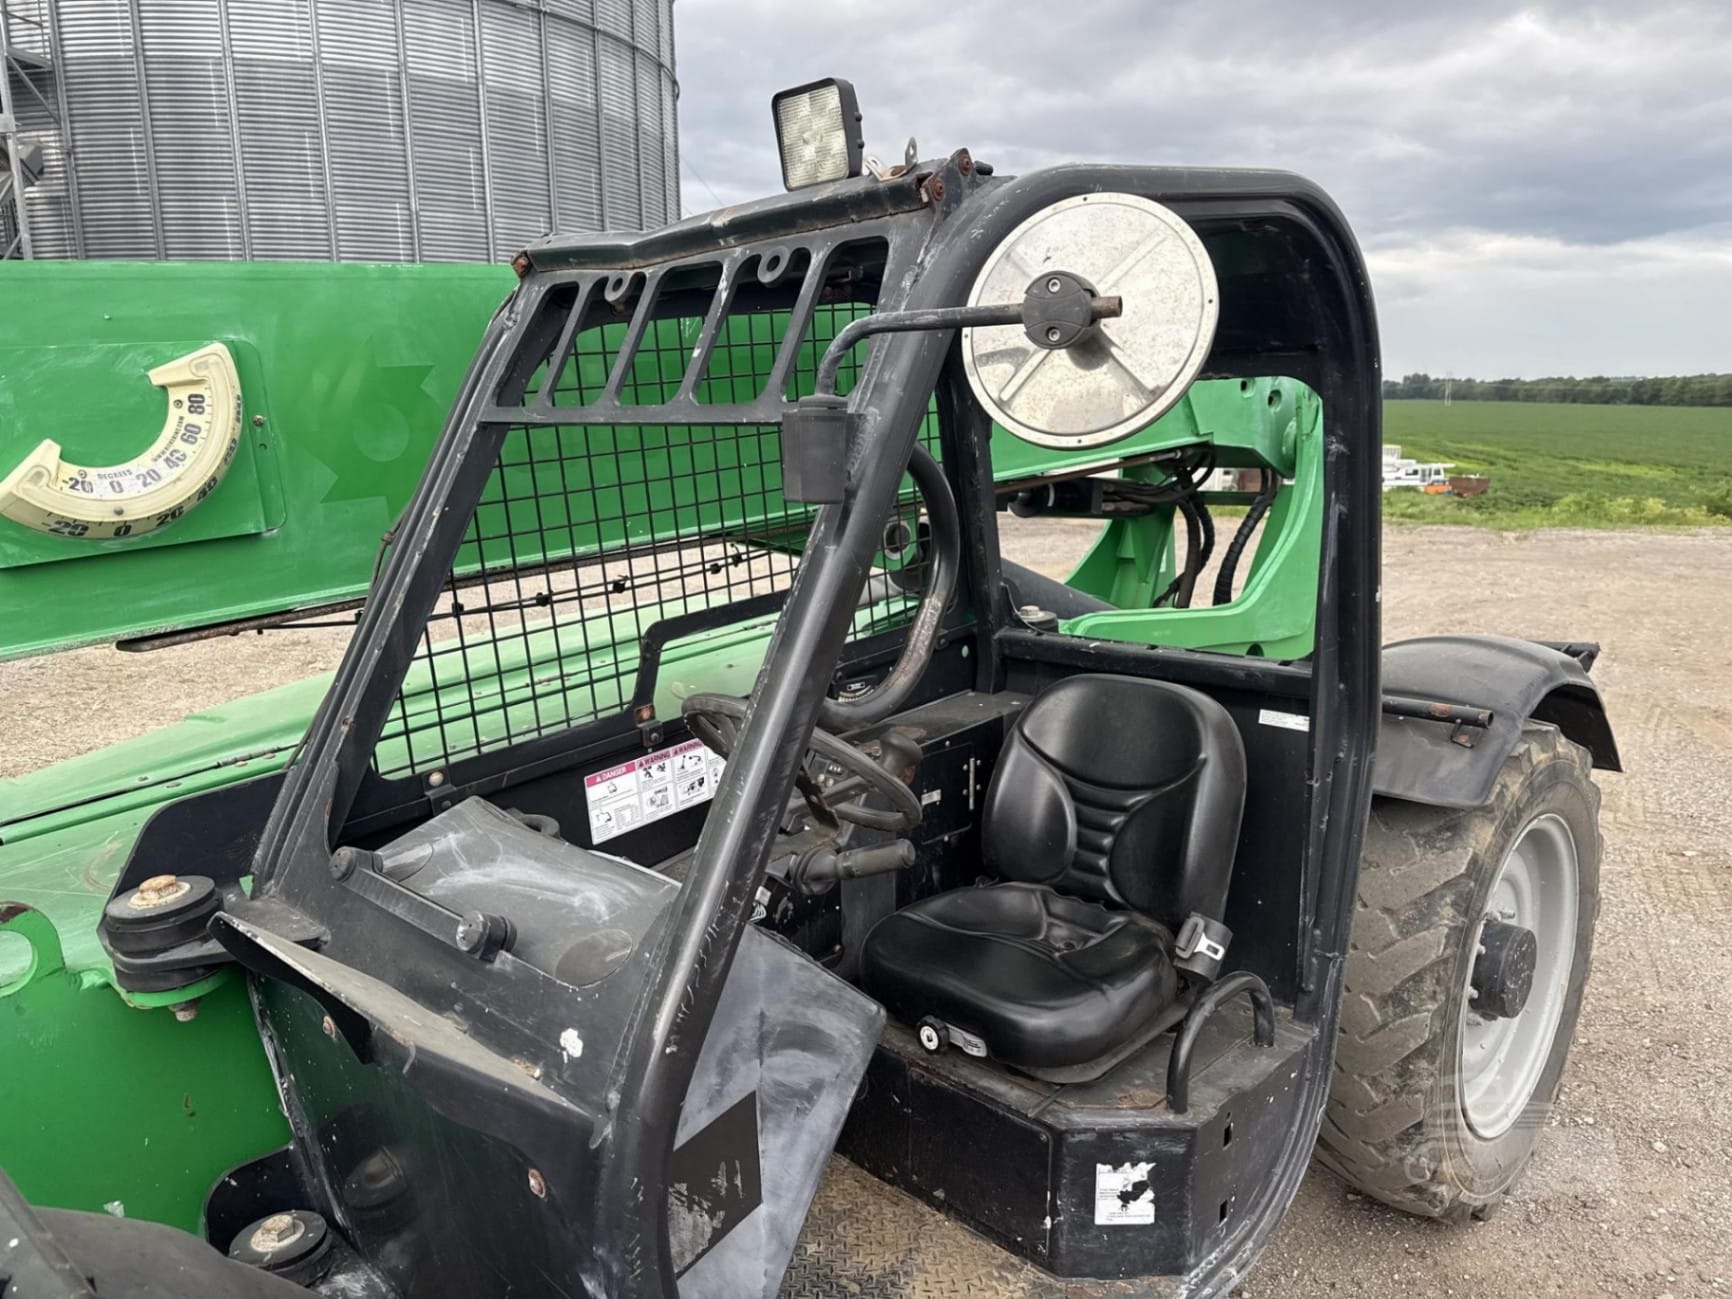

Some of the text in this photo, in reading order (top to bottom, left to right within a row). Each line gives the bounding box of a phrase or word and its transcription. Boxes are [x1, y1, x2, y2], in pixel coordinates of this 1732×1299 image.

[62, 393, 205, 494] -20 0 20 40 60 80
[97, 469, 133, 480] DEGREES
[645, 750, 671, 766] WARNING
[602, 766, 627, 781] DANGER
